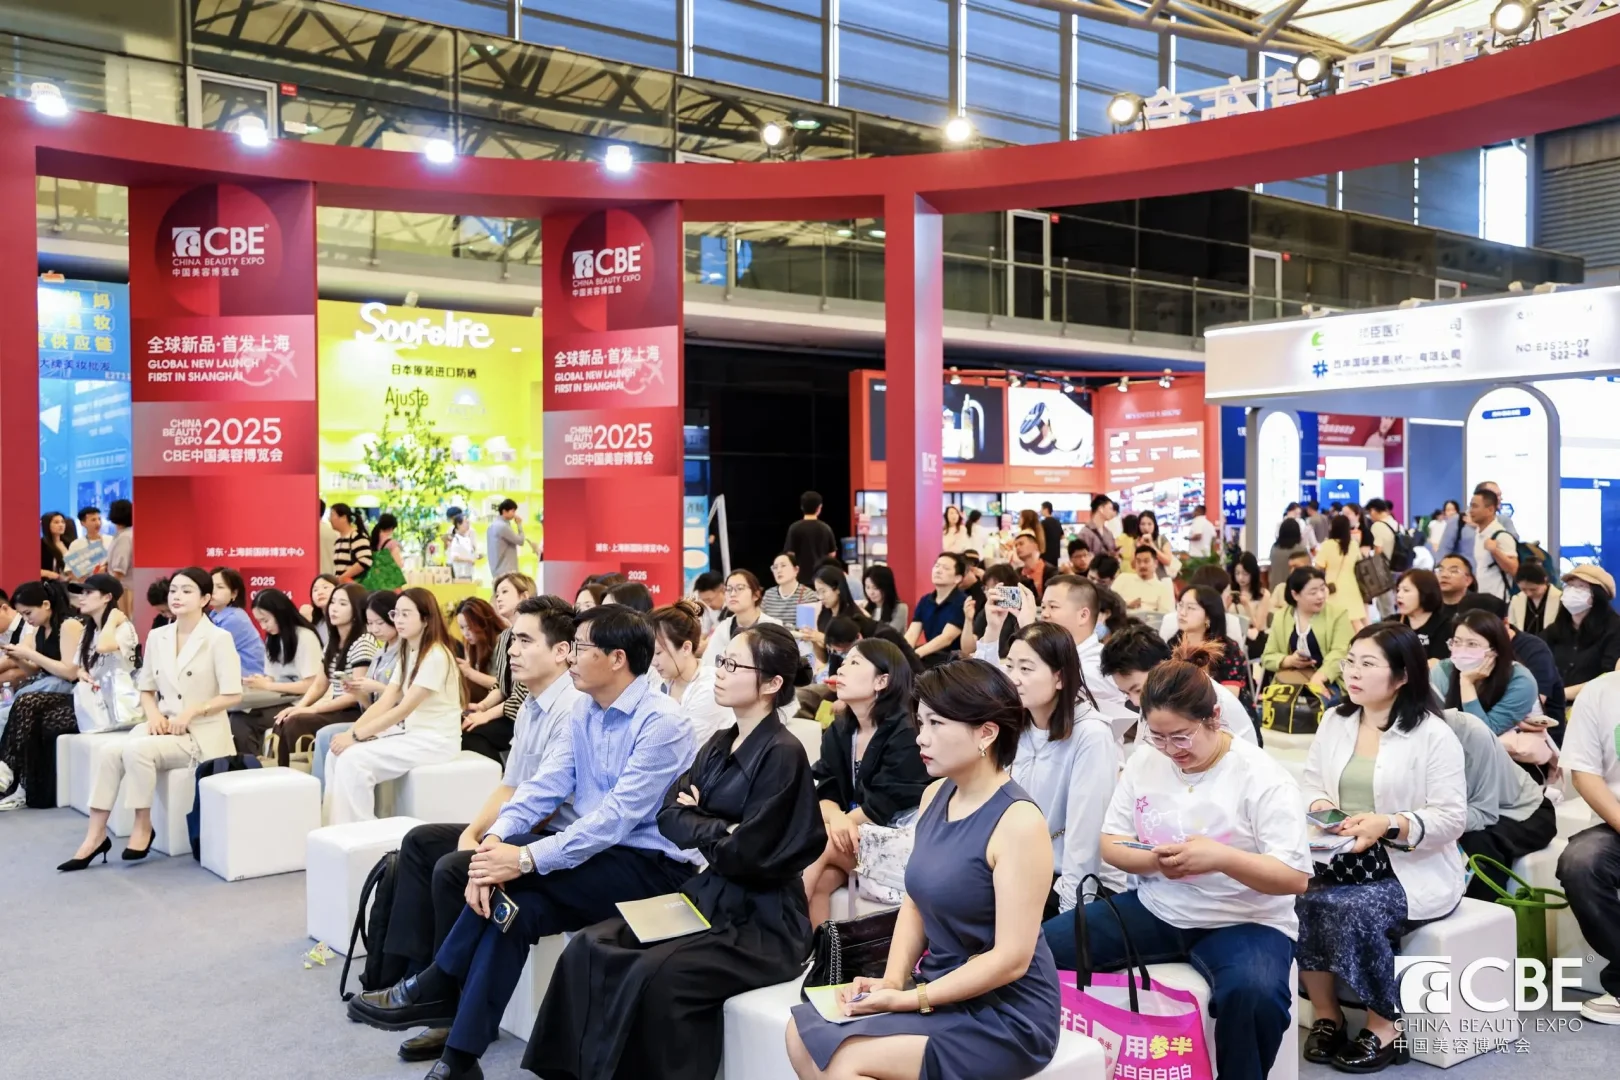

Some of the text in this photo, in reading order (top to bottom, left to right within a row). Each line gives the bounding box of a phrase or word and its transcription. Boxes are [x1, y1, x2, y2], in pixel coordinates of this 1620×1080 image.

[204, 227, 265, 256] CBE
[172, 256, 265, 267] CHINA BEAUTY EXPO
[595, 246, 642, 276] CBE
[172, 267, 240, 278] 中国美容博览会
[572, 273, 642, 288] CHINA BEAUTY EXPO
[572, 284, 623, 298] 中国美容博览会
[147, 334, 291, 354] 全球新品·首发上海
[147, 357, 259, 370] GLOBAL NEW LAUNCH
[554, 345, 660, 369] 全球新品·首发上海
[147, 370, 244, 382] FIRST IN SHANGHAI
[391, 363, 477, 379] 日本原装进口防晒
[554, 368, 636, 382] GLOBAL NEW LAUNCH
[554, 380, 625, 394] FIRST IN SHANGHAI
[385, 386, 429, 412] Ajuste
[162, 428, 202, 437] BEAUTY
[169, 417, 282, 446] CHINA 2025
[564, 433, 593, 443] BEAUTY
[569, 423, 653, 450] CHINA 2025
[174, 436, 203, 446] EXPO
[572, 441, 594, 450] EXPO
[250, 576, 276, 587] 2025
[628, 570, 648, 581] 2025
[1124, 1034, 1194, 1061] 用参半
